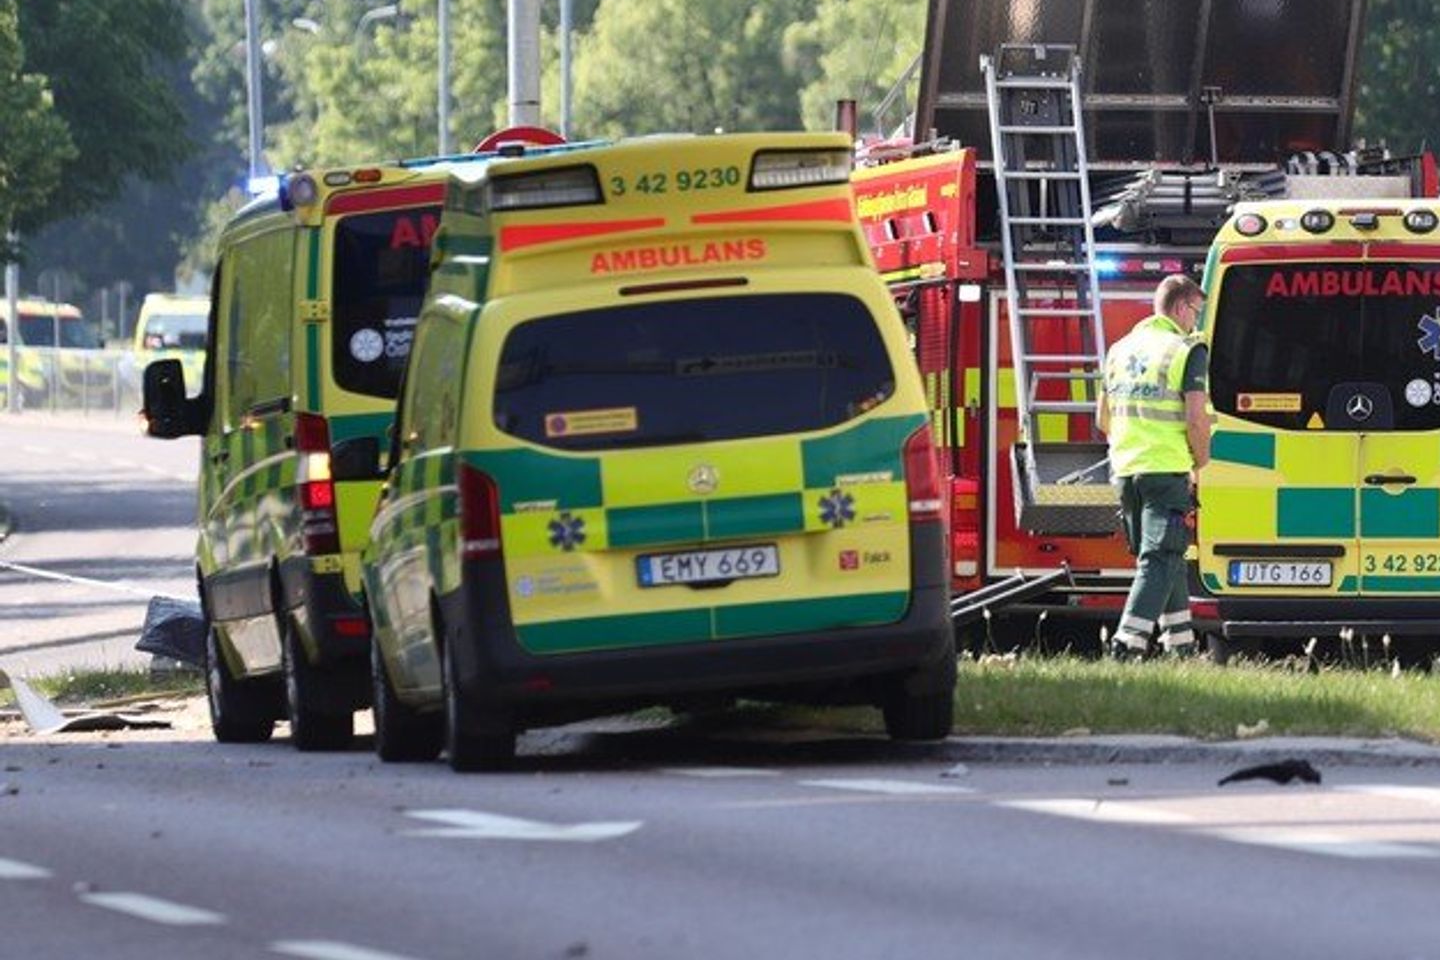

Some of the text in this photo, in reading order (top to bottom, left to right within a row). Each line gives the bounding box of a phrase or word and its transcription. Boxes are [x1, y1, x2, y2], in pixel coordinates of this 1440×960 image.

[611, 166, 741, 196] 3 42 9230
[590, 239, 766, 274] AMBULANS
[661, 549, 766, 580] EMY 669
[1246, 565, 1324, 581] UTG 166
[1365, 555, 1376, 572] 3
[1383, 555, 1407, 572] 42
